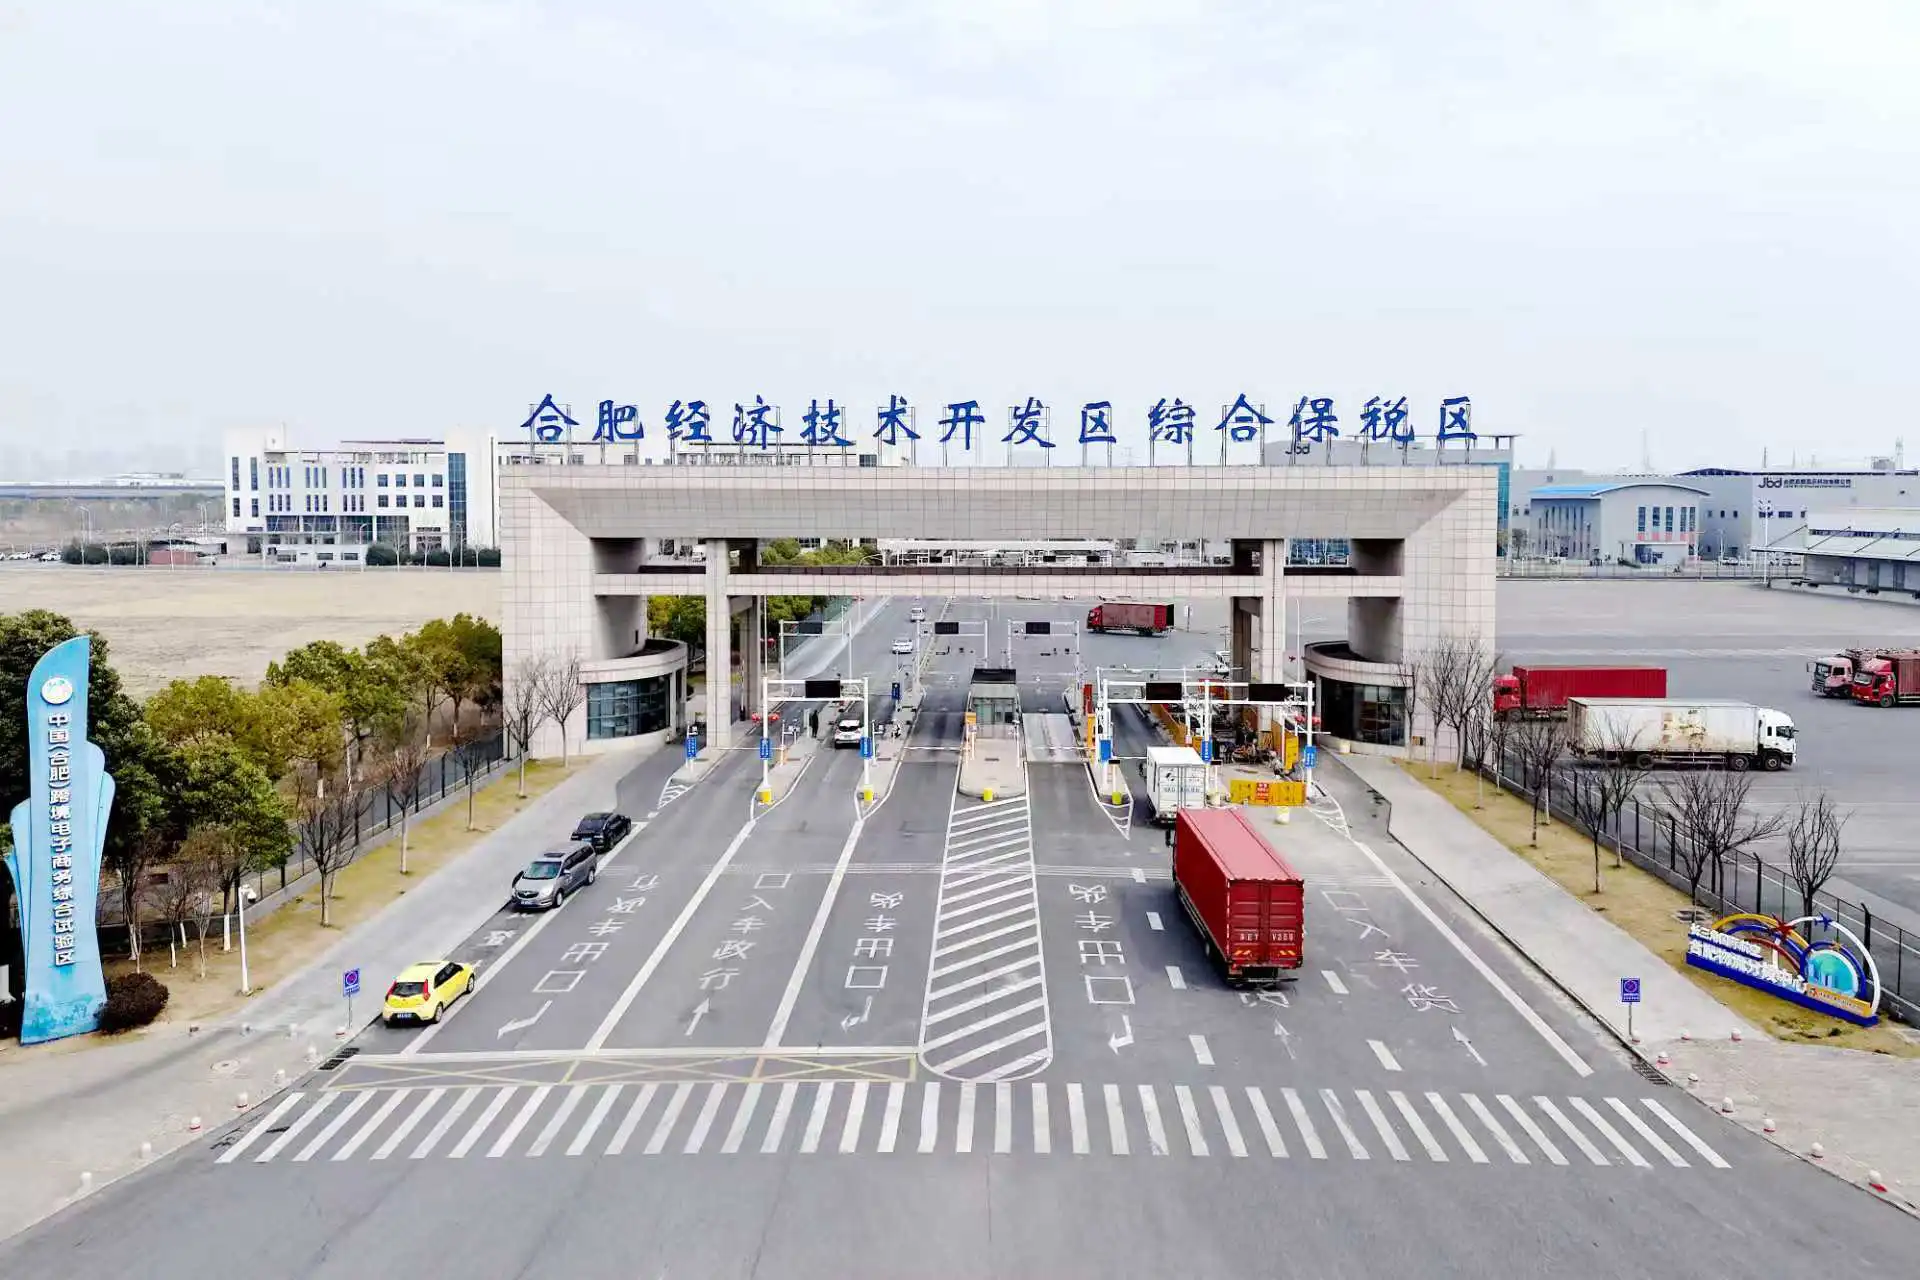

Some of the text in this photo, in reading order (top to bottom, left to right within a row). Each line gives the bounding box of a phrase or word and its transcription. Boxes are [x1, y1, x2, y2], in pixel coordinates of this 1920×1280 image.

[520, 393, 1477, 450] 合肥经济技术开发区综合保税区
